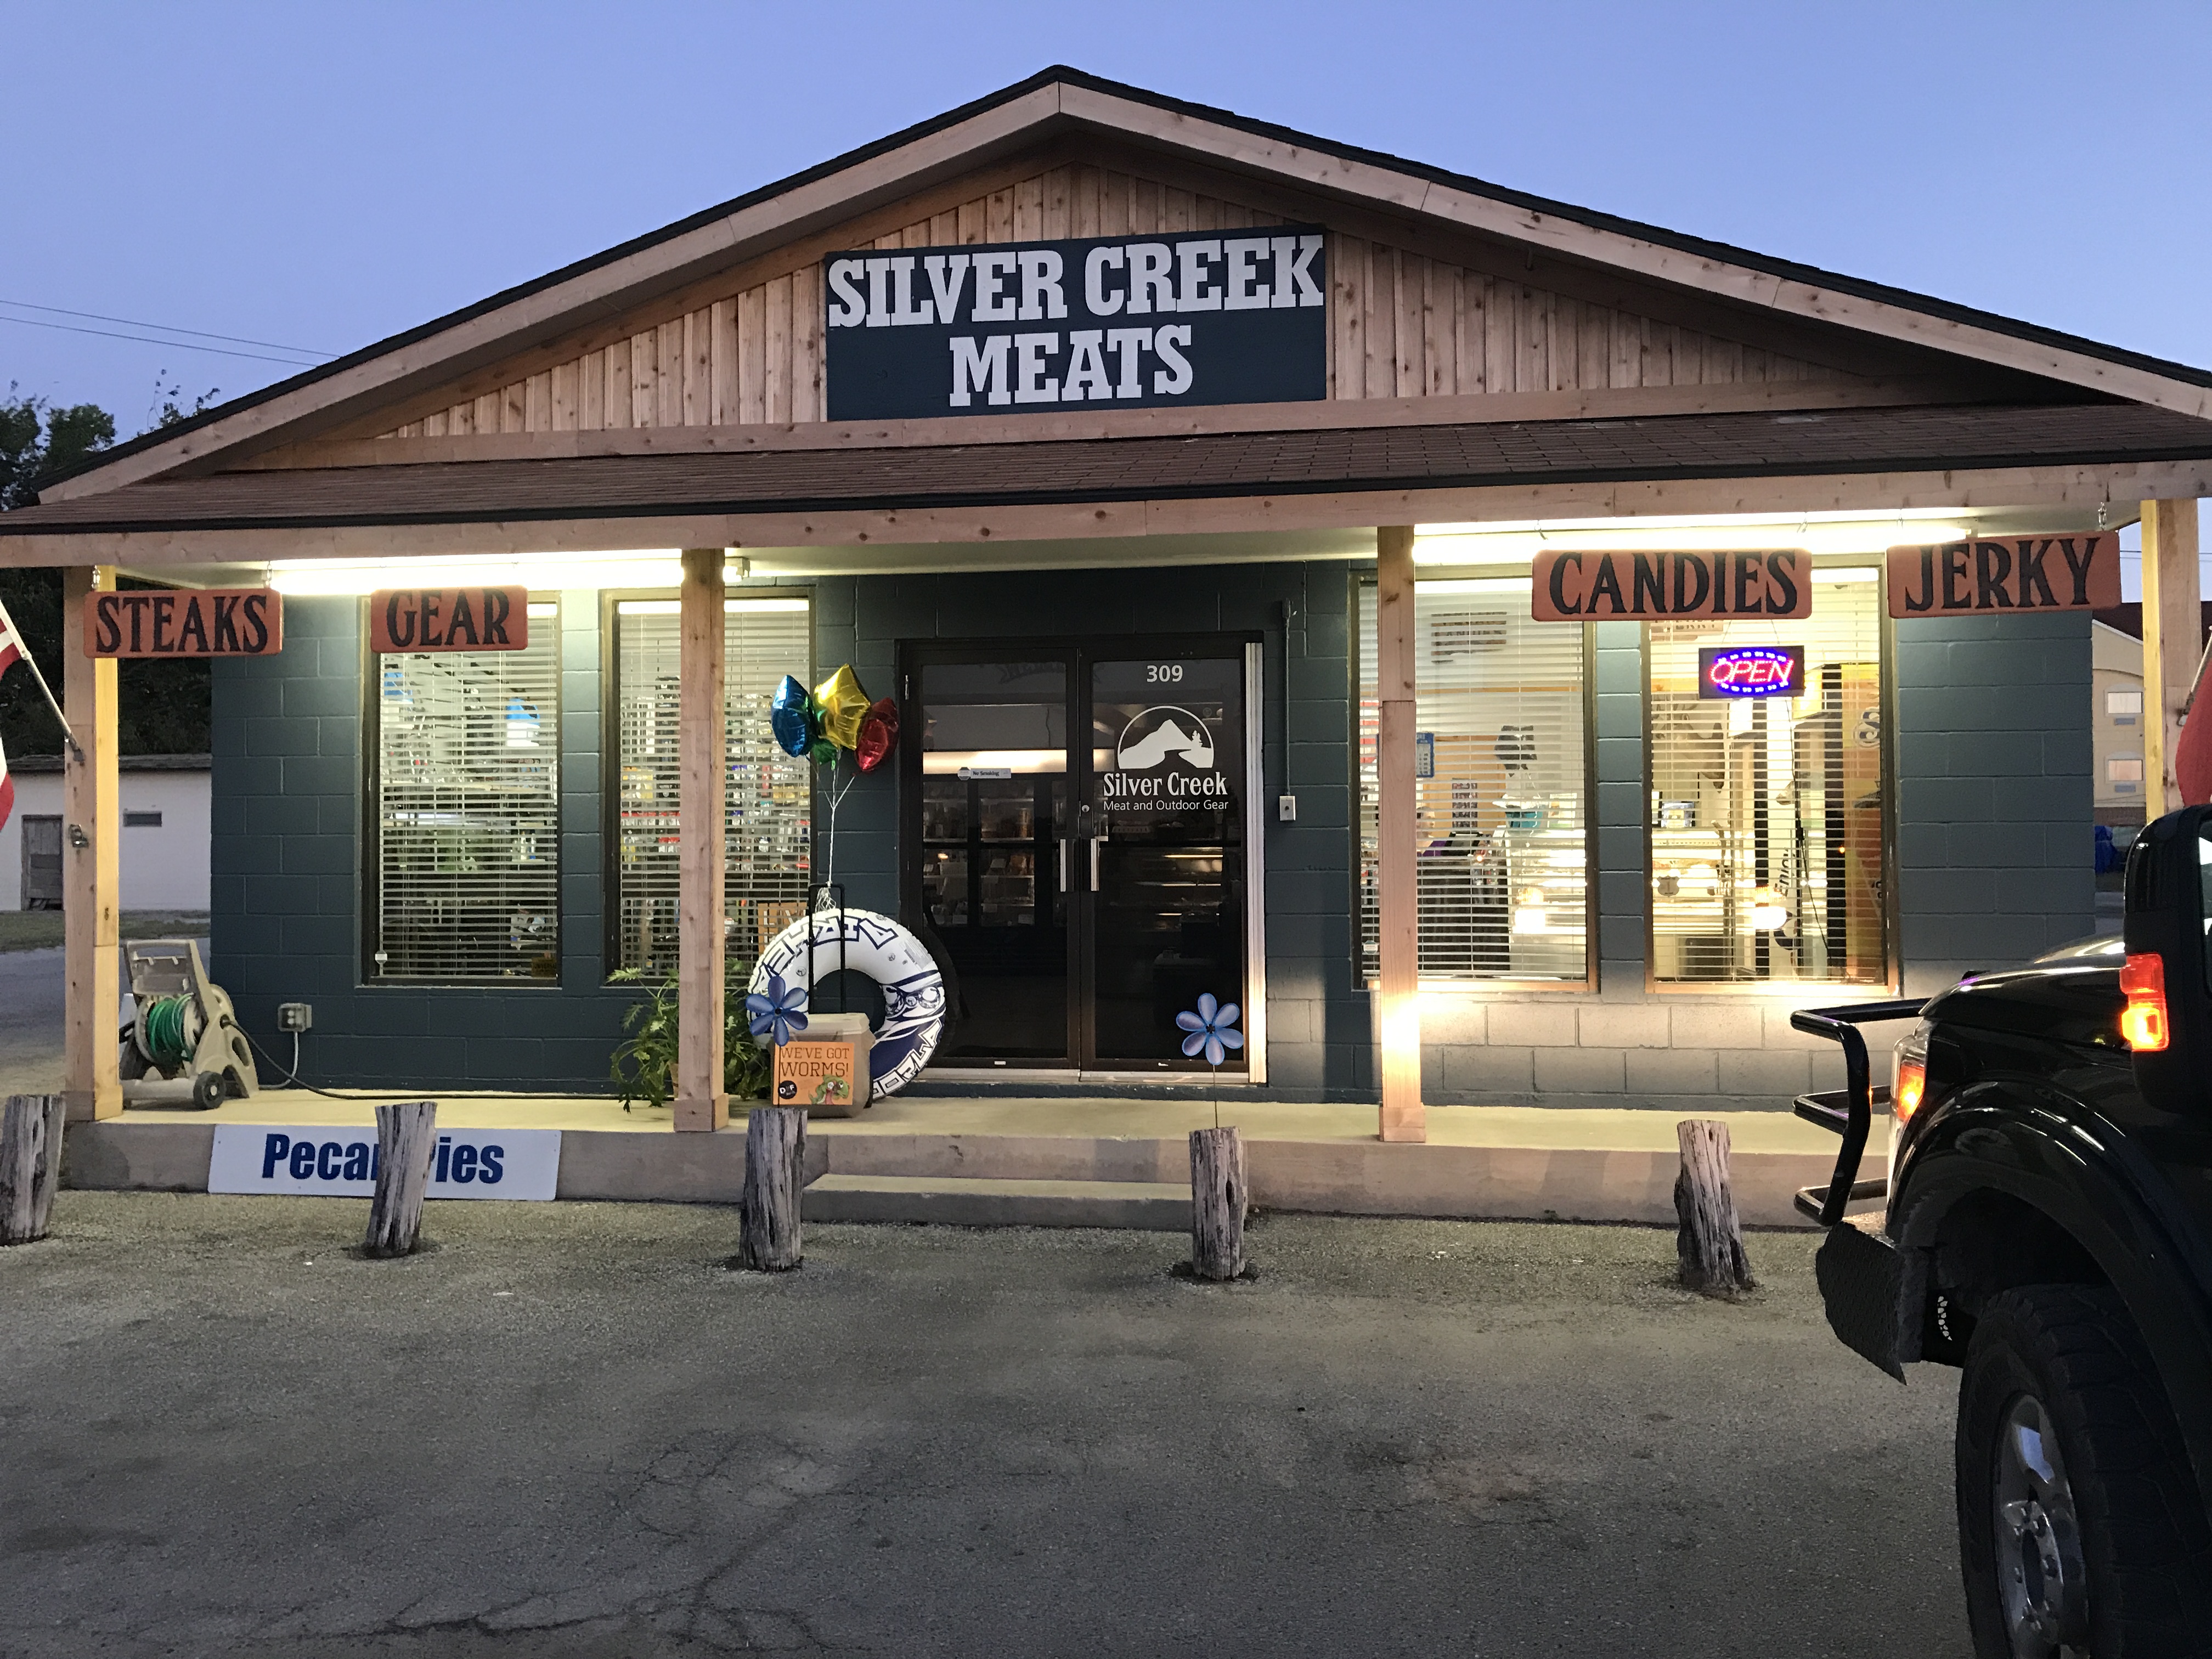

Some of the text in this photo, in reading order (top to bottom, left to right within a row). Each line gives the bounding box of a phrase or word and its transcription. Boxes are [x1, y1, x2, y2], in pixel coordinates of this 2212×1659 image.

[828, 234, 1324, 328] SILVER CREEK
[949, 324, 1193, 407] MEATS
[1549, 550, 1798, 614] CANDIES
[1905, 537, 2098, 611] JERKY
[96, 595, 268, 653] STEAKS
[386, 588, 510, 647] GEAR
[1147, 665, 1183, 682] 309
[1710, 659, 1793, 684] OPEN
[1104, 771, 1228, 796] Silver Creek
[1104, 799, 1229, 810] Meat and Outdoor Gear
[749, 915, 899, 1031] AIRHEA
[781, 1047, 850, 1059] WE'VE GOT
[781, 1062, 849, 1077] WORMS!
[873, 1018, 943, 1099] OPLA
[430, 1137, 504, 1183] ies
